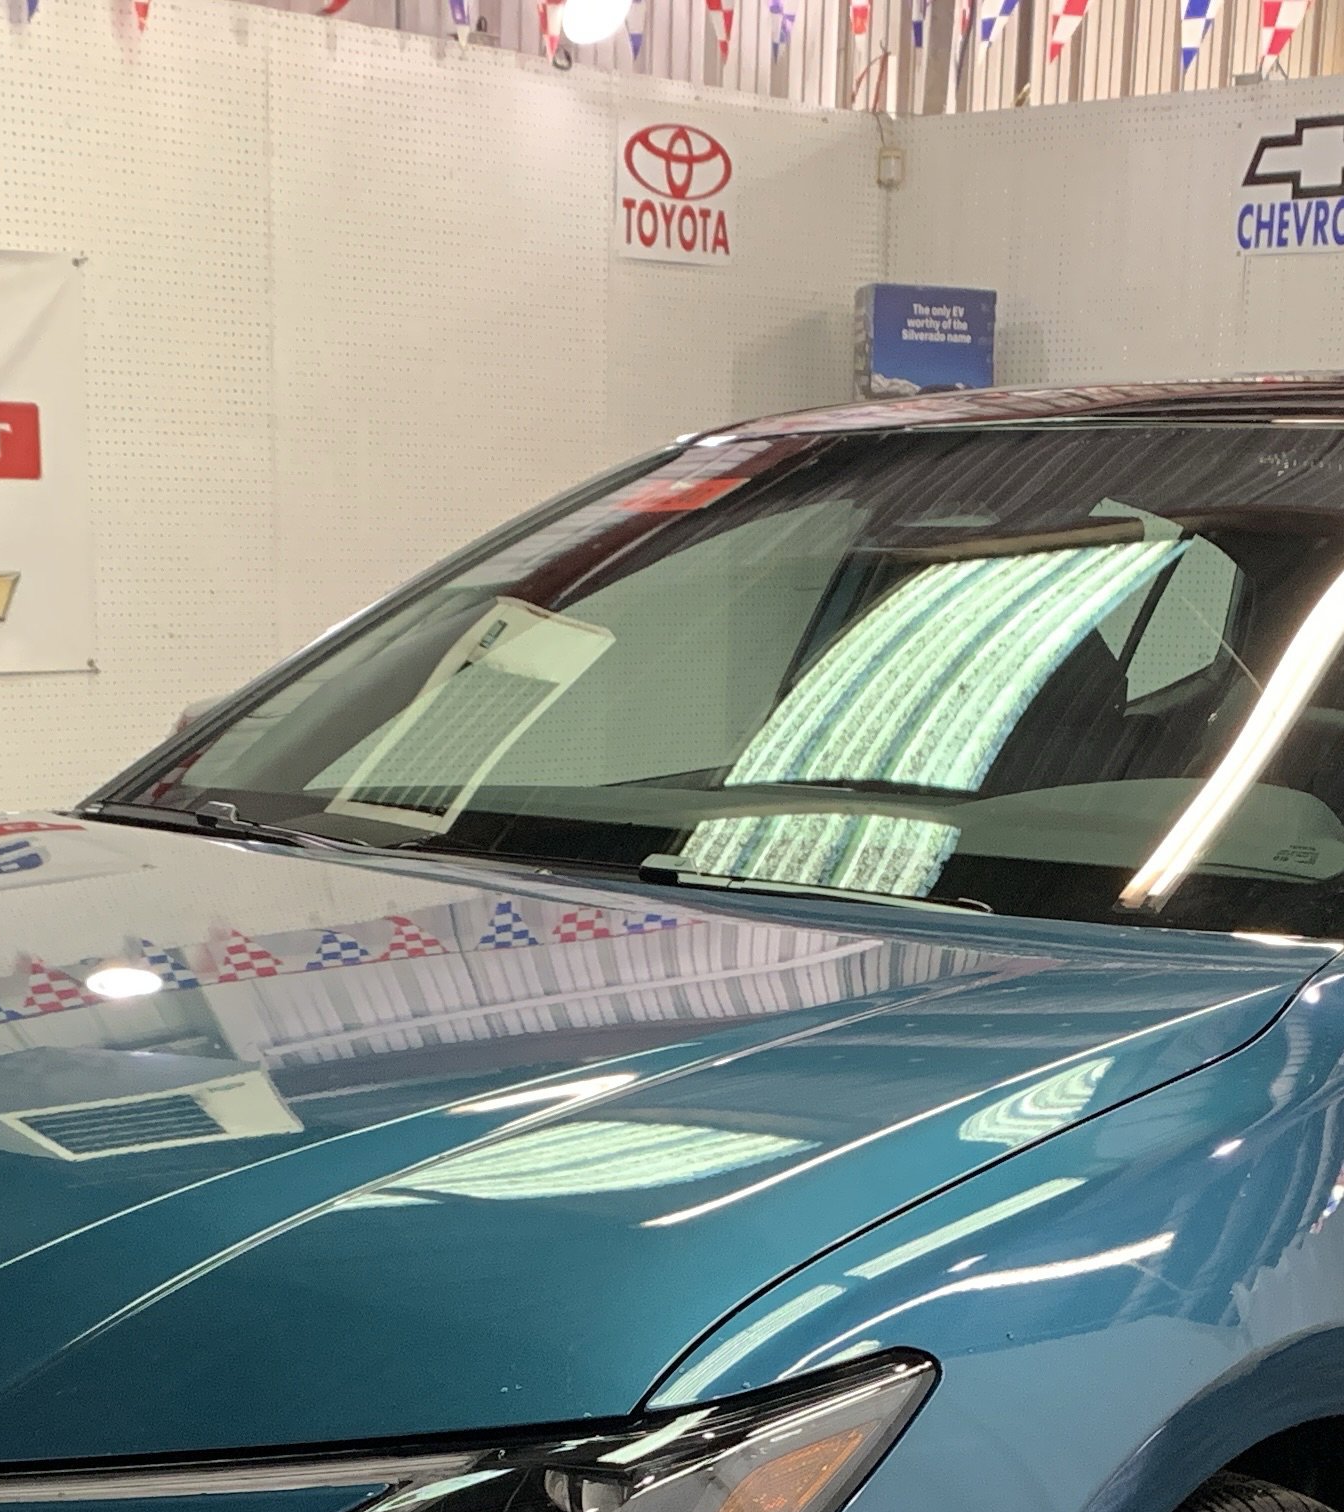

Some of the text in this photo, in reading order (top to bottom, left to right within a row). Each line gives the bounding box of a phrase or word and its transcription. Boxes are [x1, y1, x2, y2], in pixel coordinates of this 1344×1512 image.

[622, 197, 730, 255] TOYOTA
[912, 303, 931, 316] The
[907, 318, 968, 331] worthy of the
[901, 329, 972, 344] Silverado name
